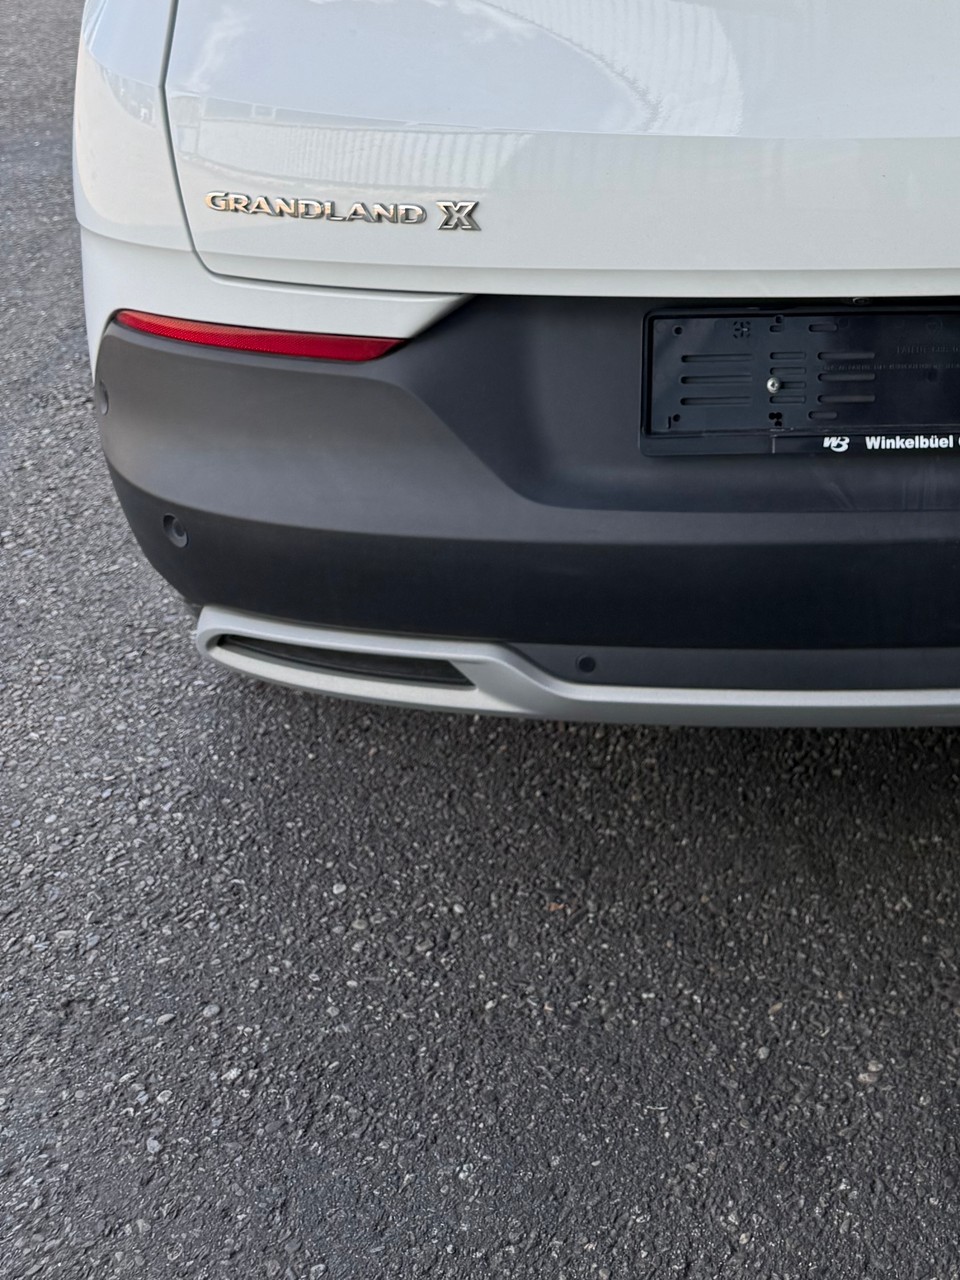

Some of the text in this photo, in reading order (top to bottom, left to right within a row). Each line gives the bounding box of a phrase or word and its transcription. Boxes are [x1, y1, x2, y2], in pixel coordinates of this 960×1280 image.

[204, 191, 481, 231] GRANDLAND X
[865, 435, 954, 450] Winkelbüel
